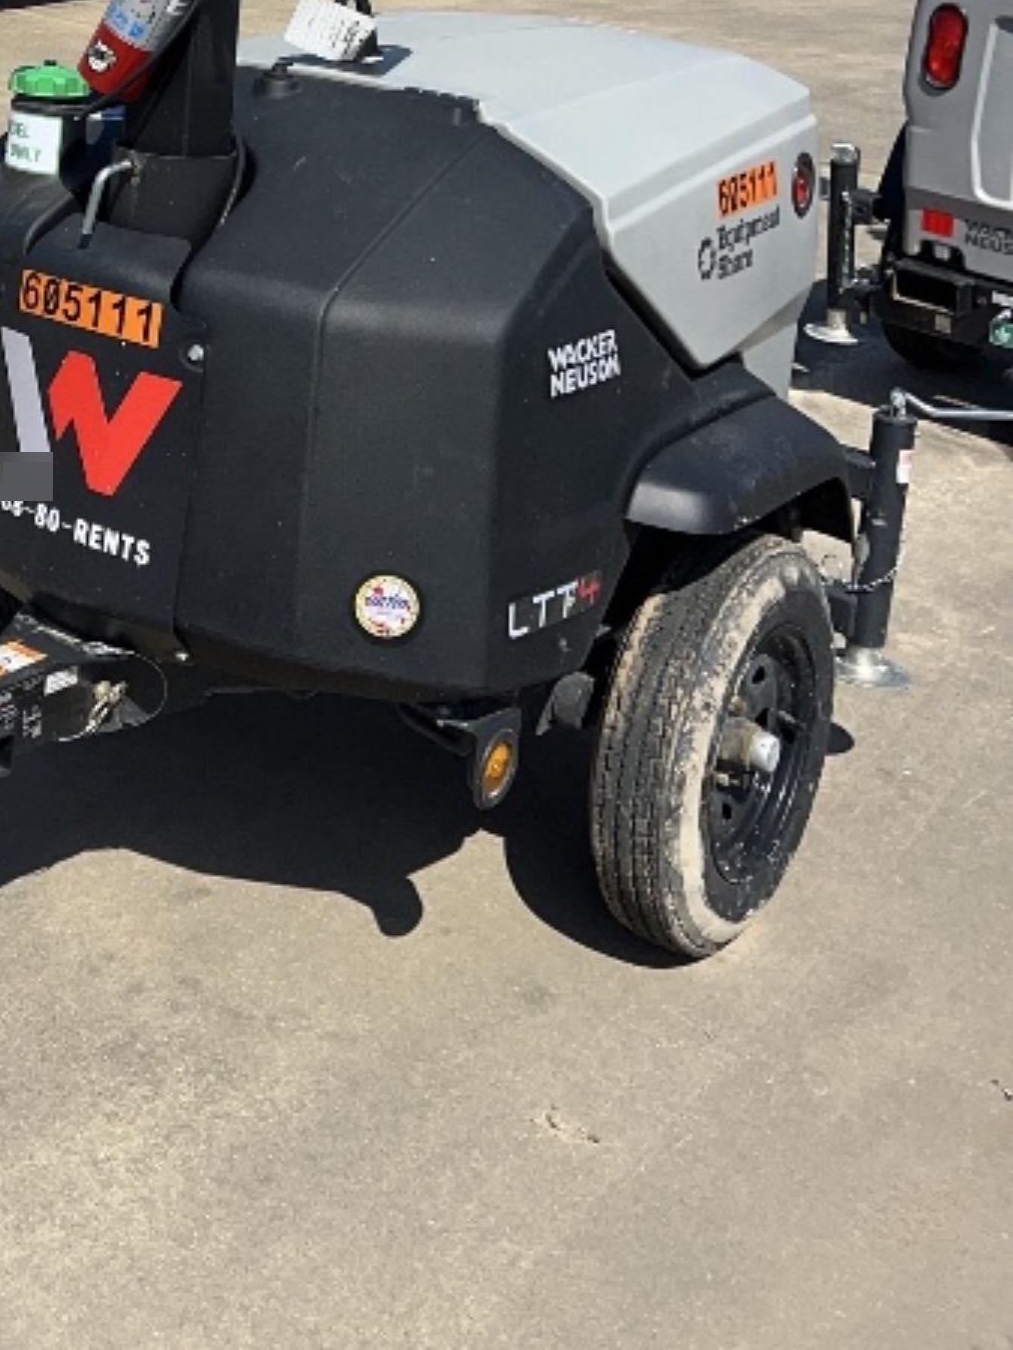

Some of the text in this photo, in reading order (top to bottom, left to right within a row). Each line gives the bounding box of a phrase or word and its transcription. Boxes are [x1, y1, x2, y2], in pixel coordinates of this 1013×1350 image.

[22, 272, 155, 343] 605111
[548, 329, 618, 372] WACKER
[550, 353, 621, 399] NEUSON
